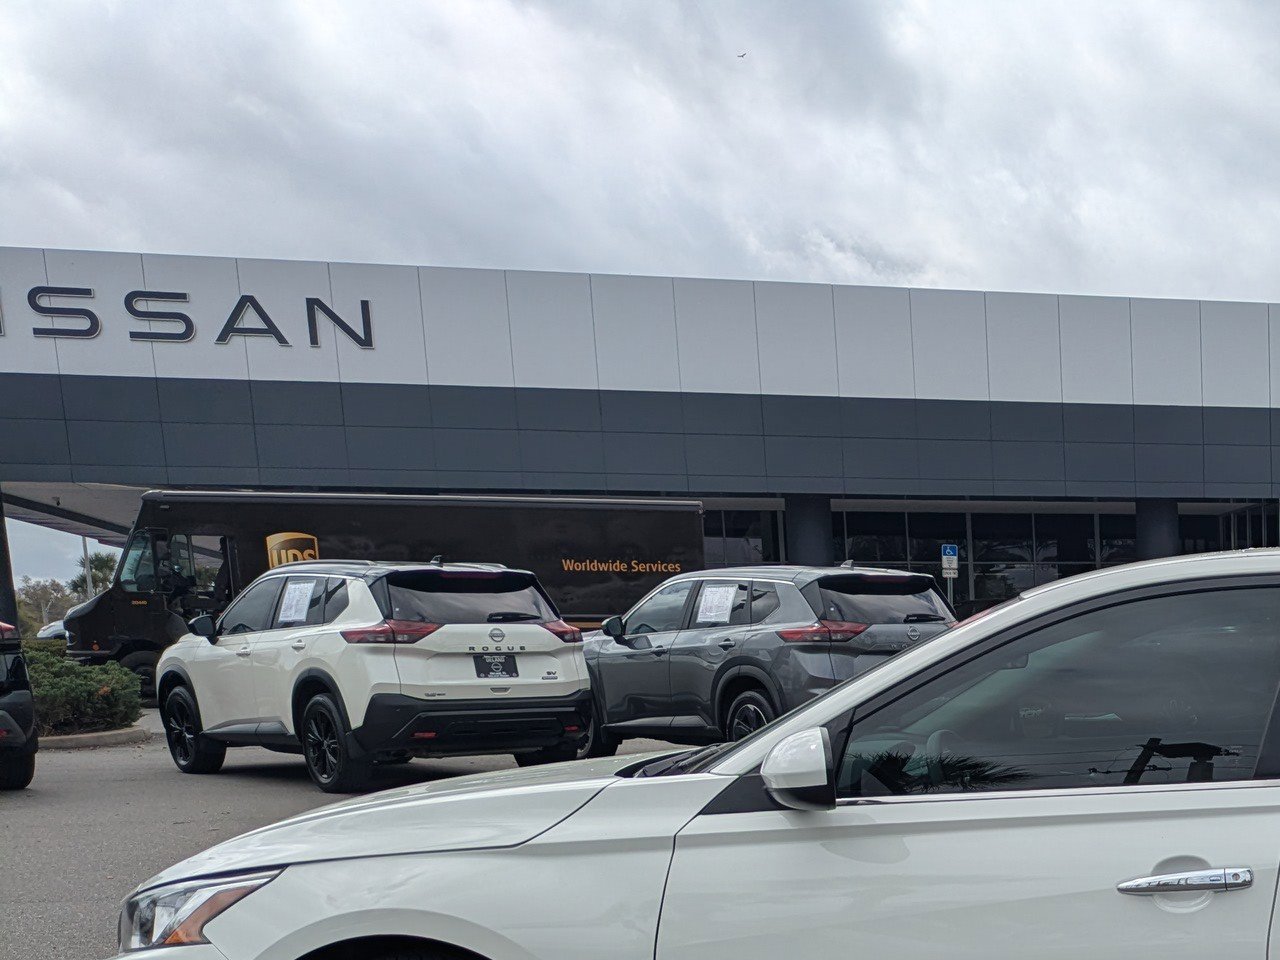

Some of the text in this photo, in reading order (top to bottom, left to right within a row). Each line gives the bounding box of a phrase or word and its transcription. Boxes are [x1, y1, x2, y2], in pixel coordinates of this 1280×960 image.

[0, 286, 375, 350] SSAN
[562, 559, 681, 573] Worldwide Services
